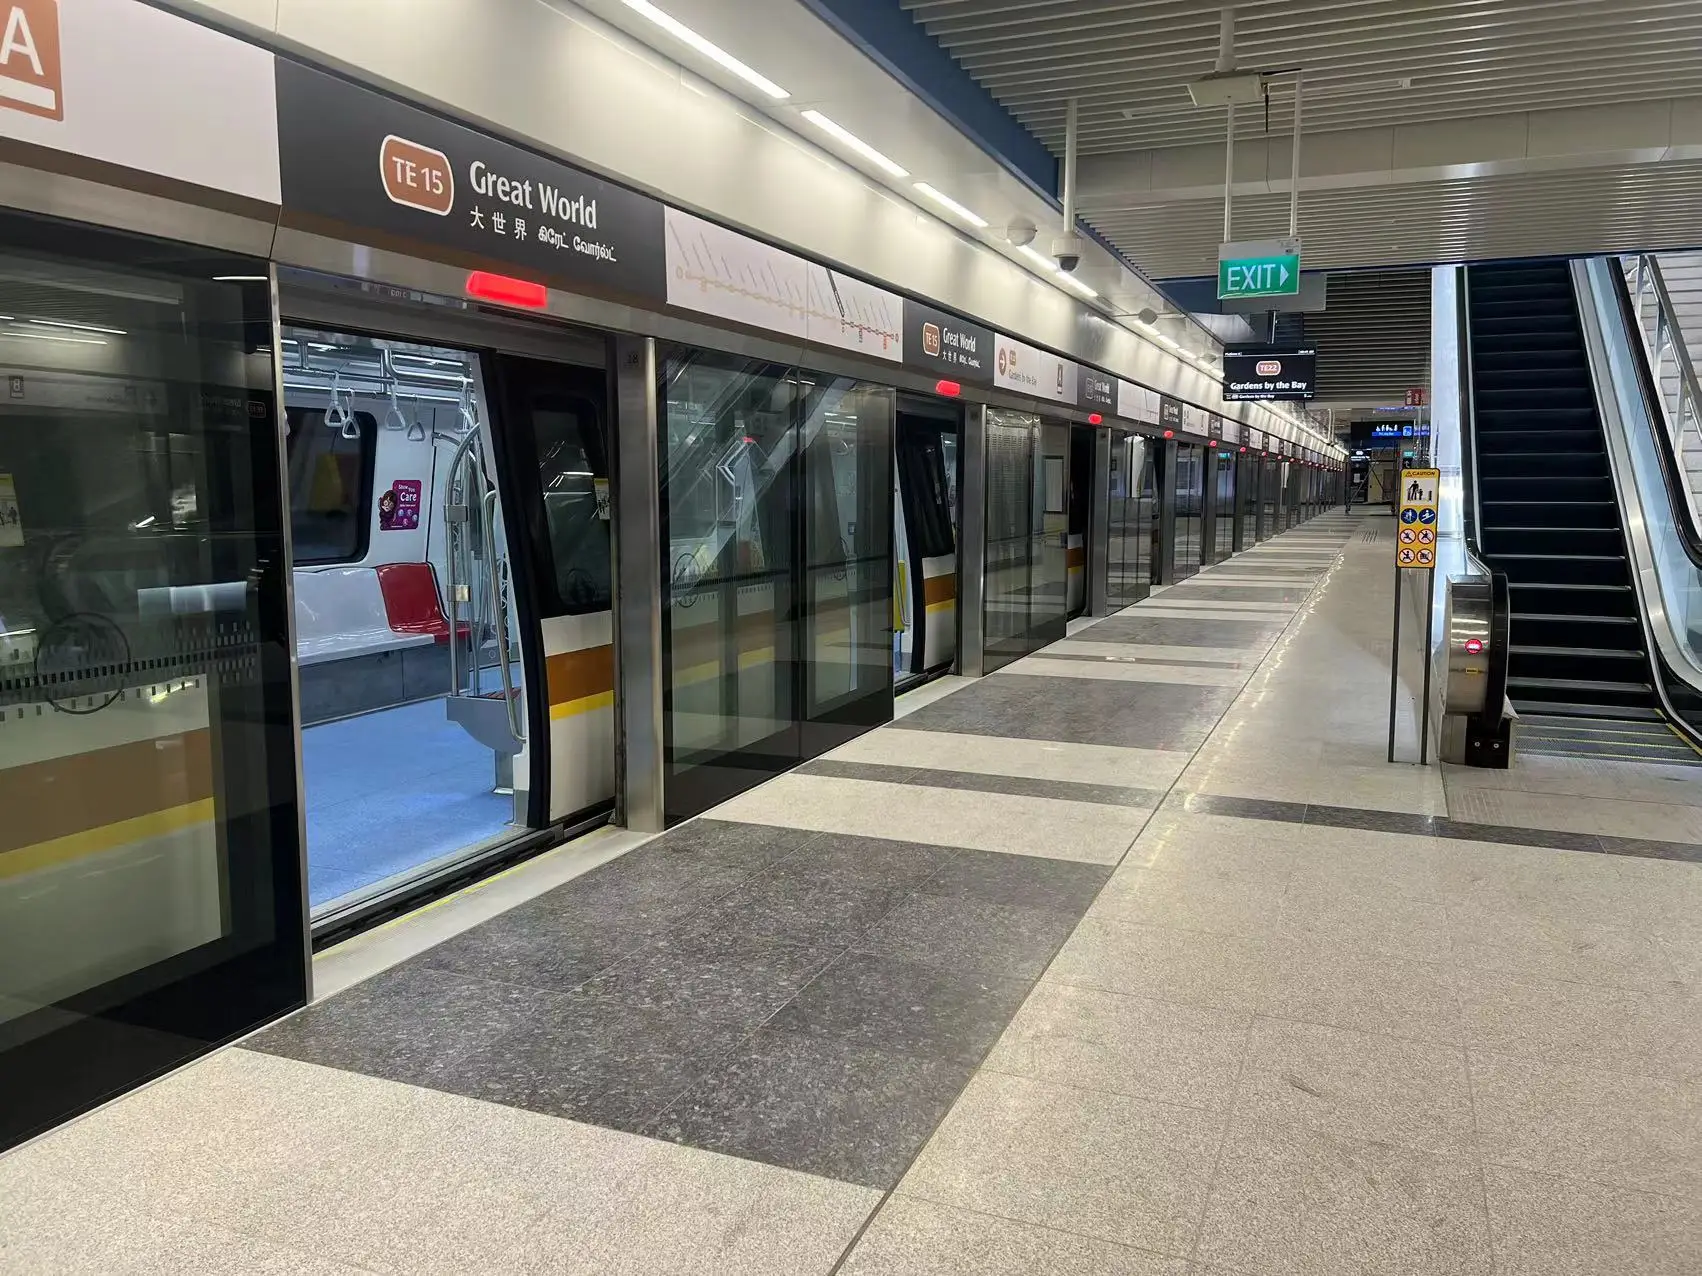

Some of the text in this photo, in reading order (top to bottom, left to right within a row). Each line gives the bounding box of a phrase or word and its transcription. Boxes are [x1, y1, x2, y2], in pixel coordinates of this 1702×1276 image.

[0, 5, 44, 76] A
[469, 160, 597, 229] Great World
[1227, 264, 1276, 291] EXIT
[943, 327, 976, 353] Great World
[1230, 381, 1307, 391] Gardens by the Bay
[400, 492, 416, 501] Care
